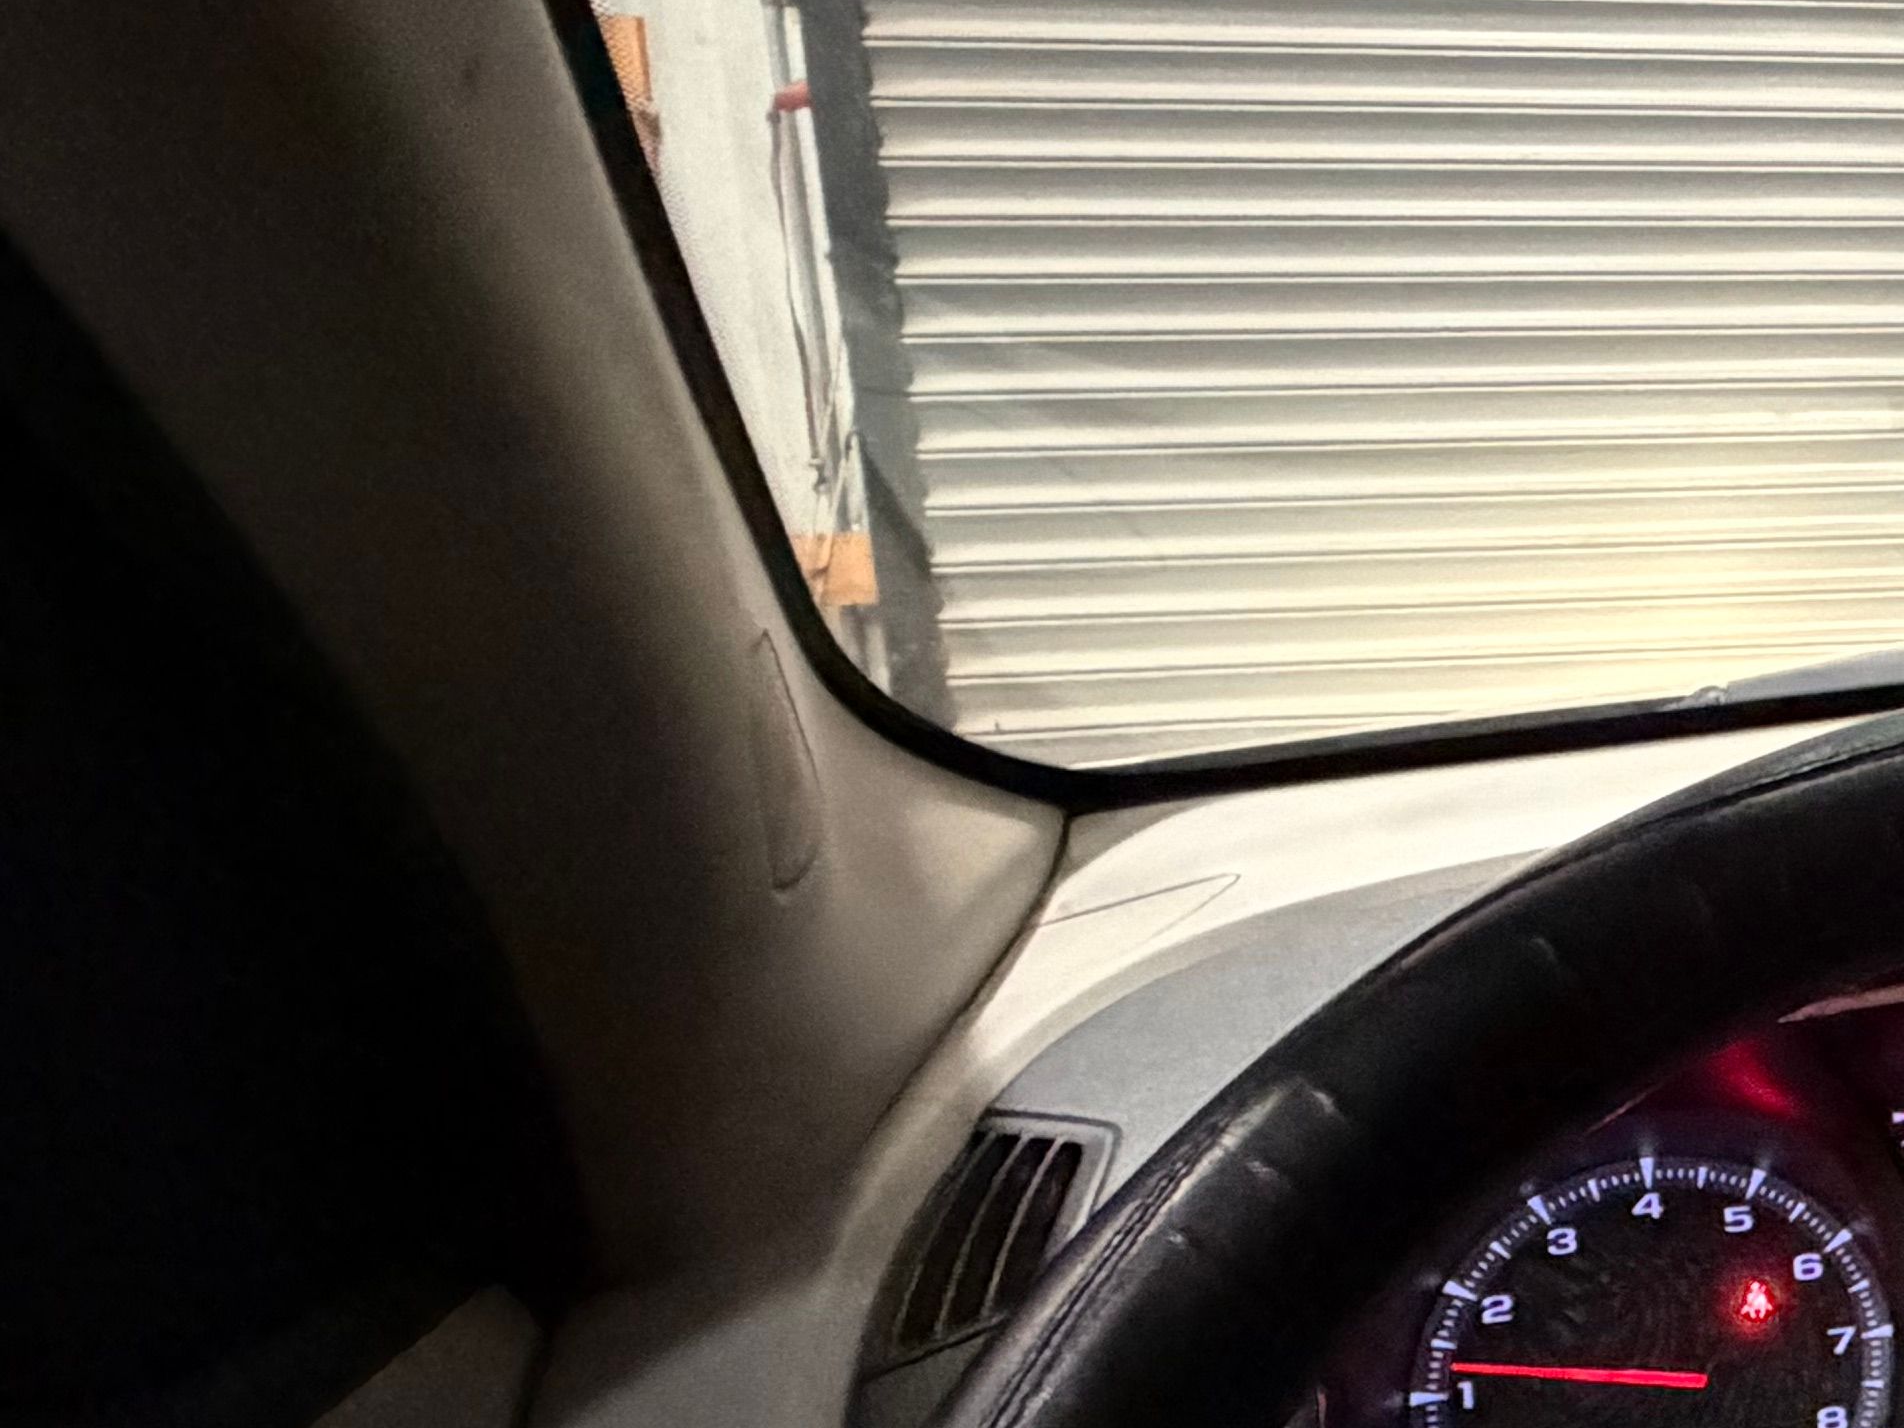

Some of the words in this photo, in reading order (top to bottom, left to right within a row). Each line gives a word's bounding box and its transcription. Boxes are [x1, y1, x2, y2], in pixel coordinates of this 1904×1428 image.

[1632, 1192, 1665, 1220] 4
[1723, 1205, 1755, 1233] 5
[1546, 1227, 1578, 1256] 3
[1792, 1253, 1824, 1281] 6
[1480, 1294, 1514, 1325] 2
[1826, 1325, 1857, 1355] 7
[1456, 1381, 1476, 1410] 1
